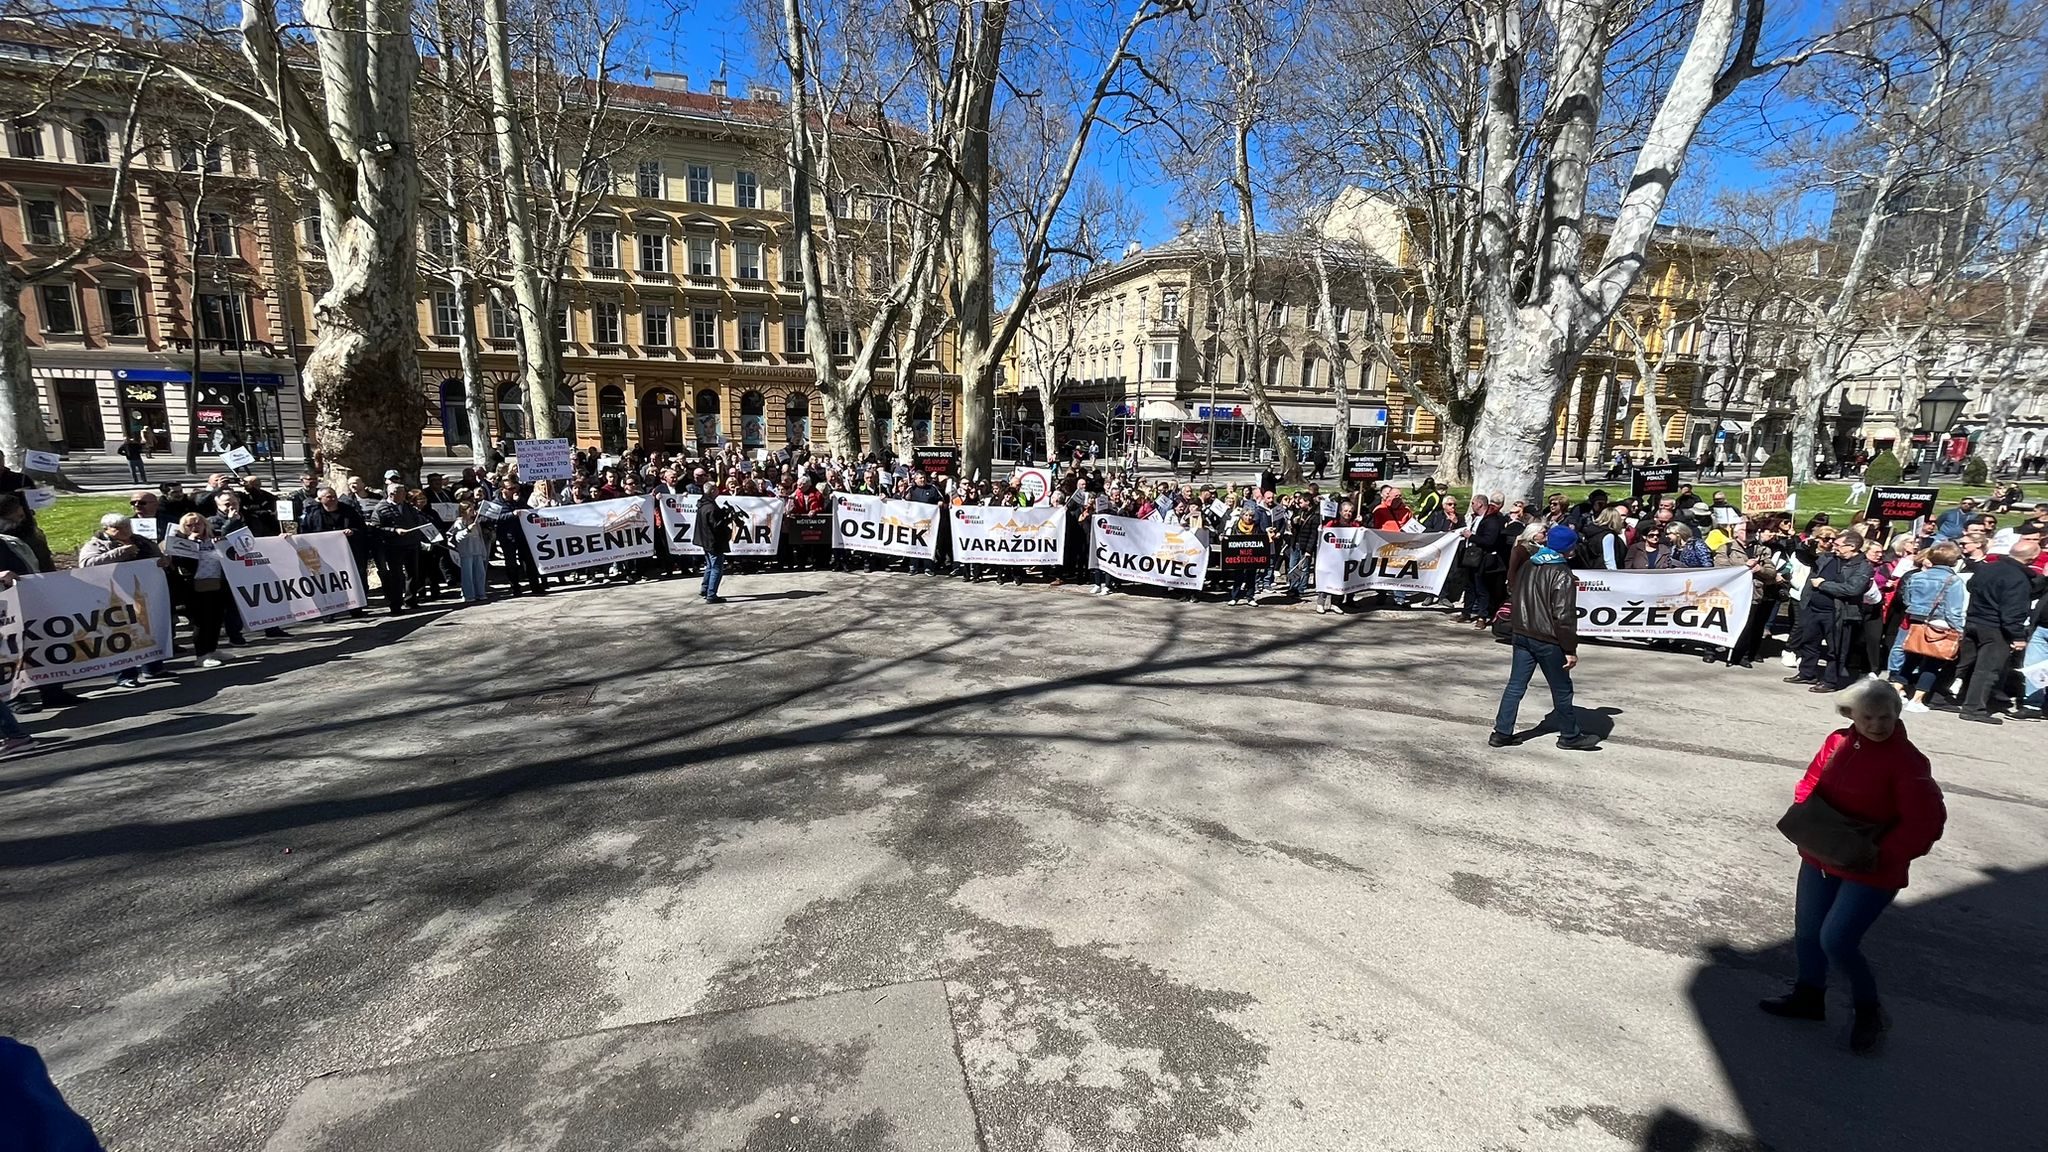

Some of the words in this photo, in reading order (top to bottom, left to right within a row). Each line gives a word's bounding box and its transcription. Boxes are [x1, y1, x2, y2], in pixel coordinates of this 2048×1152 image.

[1877, 492, 1910, 500] VRHOVNI
[1911, 493, 1932, 501] SUDE
[536, 525, 653, 561] ŠIBENIK
[840, 518, 928, 547] OSIJEK
[959, 534, 1058, 553] VARAŽDIN
[1096, 542, 1197, 579] ČAKOVEC
[1343, 557, 1419, 582] PULA
[236, 570, 352, 608] VUKOVAR
